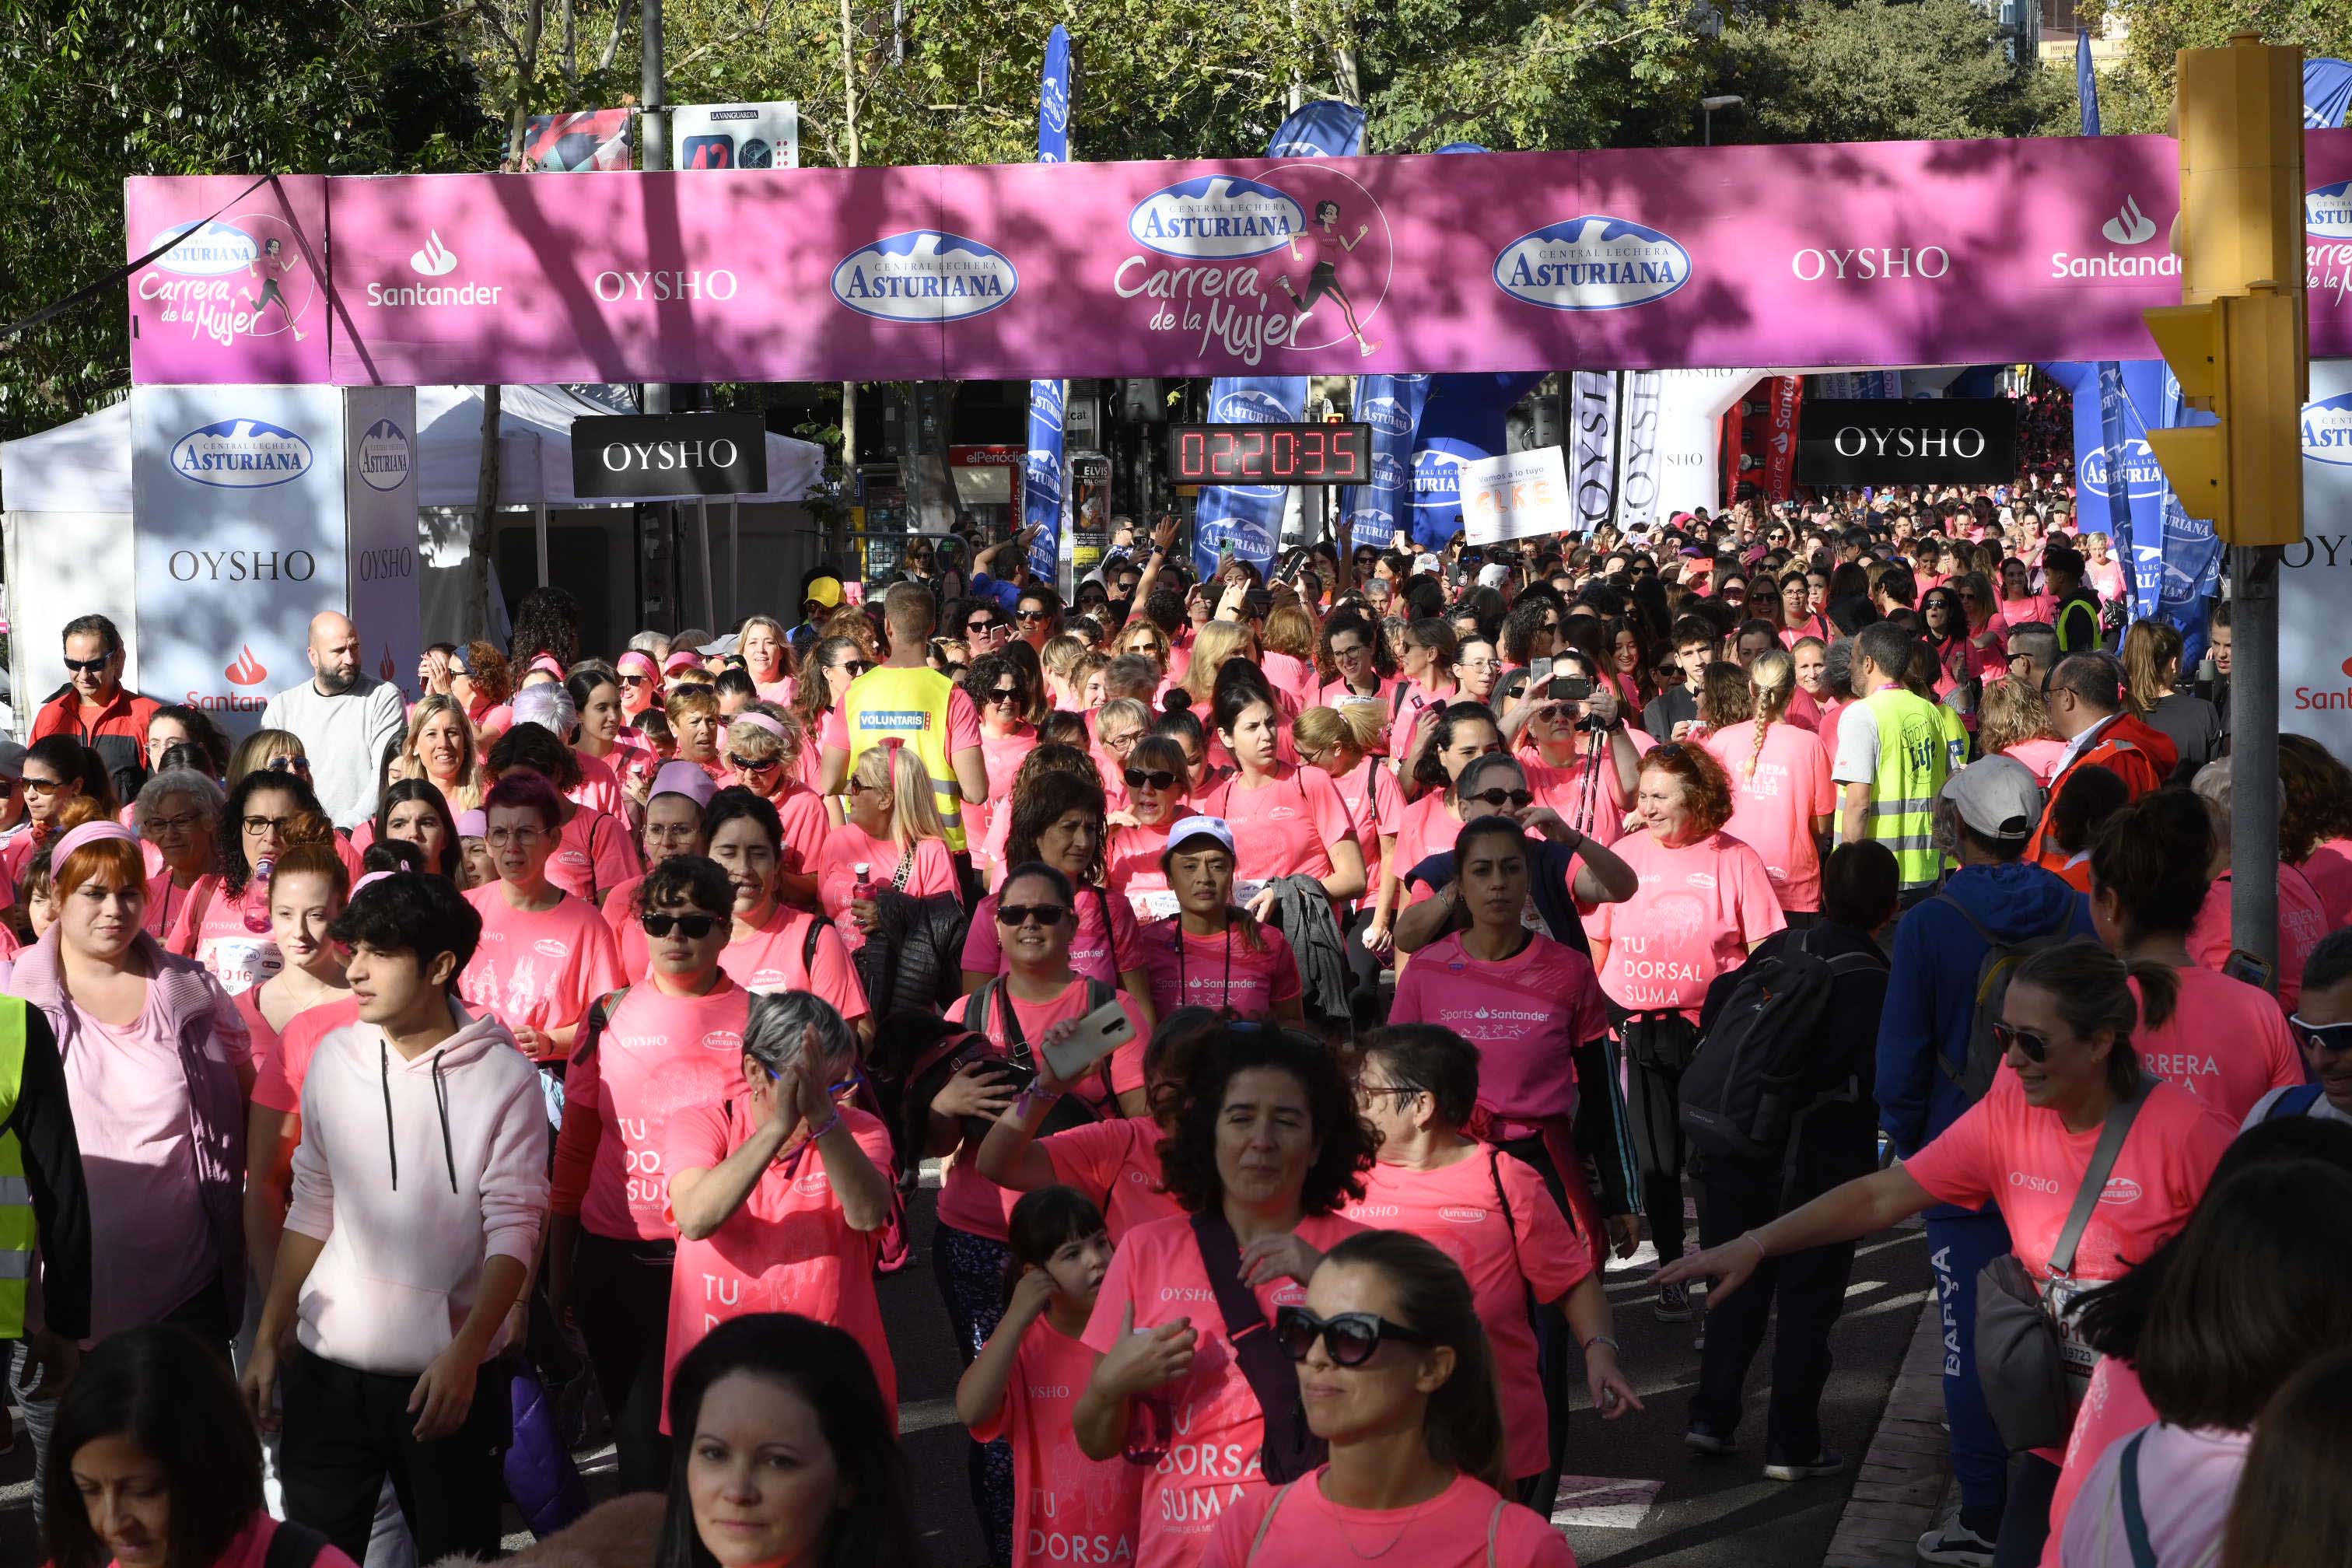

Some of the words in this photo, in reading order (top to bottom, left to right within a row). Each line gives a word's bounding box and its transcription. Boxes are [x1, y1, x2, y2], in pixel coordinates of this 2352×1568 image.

[1170, 205, 1225, 213] CENTRAL
[1230, 204, 1287, 212] LECHERA
[1143, 207, 1292, 238] ASTURIANA
[874, 262, 933, 271] CENTRAL
[939, 261, 997, 271] LECHERA
[1539, 250, 1600, 259] CENTRAL
[1607, 247, 1670, 257] LECHERA
[1792, 246, 1950, 281] OYSHO
[845, 265, 1004, 299] ASTURIANA
[1114, 256, 1258, 299] Carrera
[1508, 252, 1676, 286] ASTURIANA
[138, 272, 230, 301] Carrera
[367, 281, 502, 307] Santander
[595, 270, 737, 303] OYSHO
[162, 303, 178, 322] de
[182, 301, 194, 322] la
[192, 297, 265, 347] Mujer
[1150, 301, 1176, 331] de
[1182, 301, 1202, 331] la
[1199, 292, 1313, 366] Mujer
[603, 439, 737, 471] OYSHO
[1182, 432, 1354, 474] 02:20:35
[1835, 426, 1986, 459] OYSHO
[182, 444, 303, 471] ASTURIANA
[362, 446, 407, 474] ASTURIANA
[1083, 467, 1108, 476] ELVIS
[169, 551, 315, 581] OYSHO
[360, 547, 411, 582] OYSHO
[861, 716, 922, 726] VOLUNTARIS
[1178, 818, 1226, 835] adid
[205, 922, 243, 930] OYSHO
[1621, 936, 1646, 954] TU
[1625, 961, 1703, 982] DORSAL
[1625, 984, 1680, 1005] SUMA
[1440, 1008, 1473, 1021] Sports
[1491, 1008, 1549, 1022] Santander
[621, 1034, 667, 1047] OYSHO
[2139, 1053, 2221, 1076] RRERA
[1349, 1206, 1398, 1220] OYSHO
[1441, 1208, 1483, 1219] ASTURIANA
[702, 1272, 739, 1306] TU
